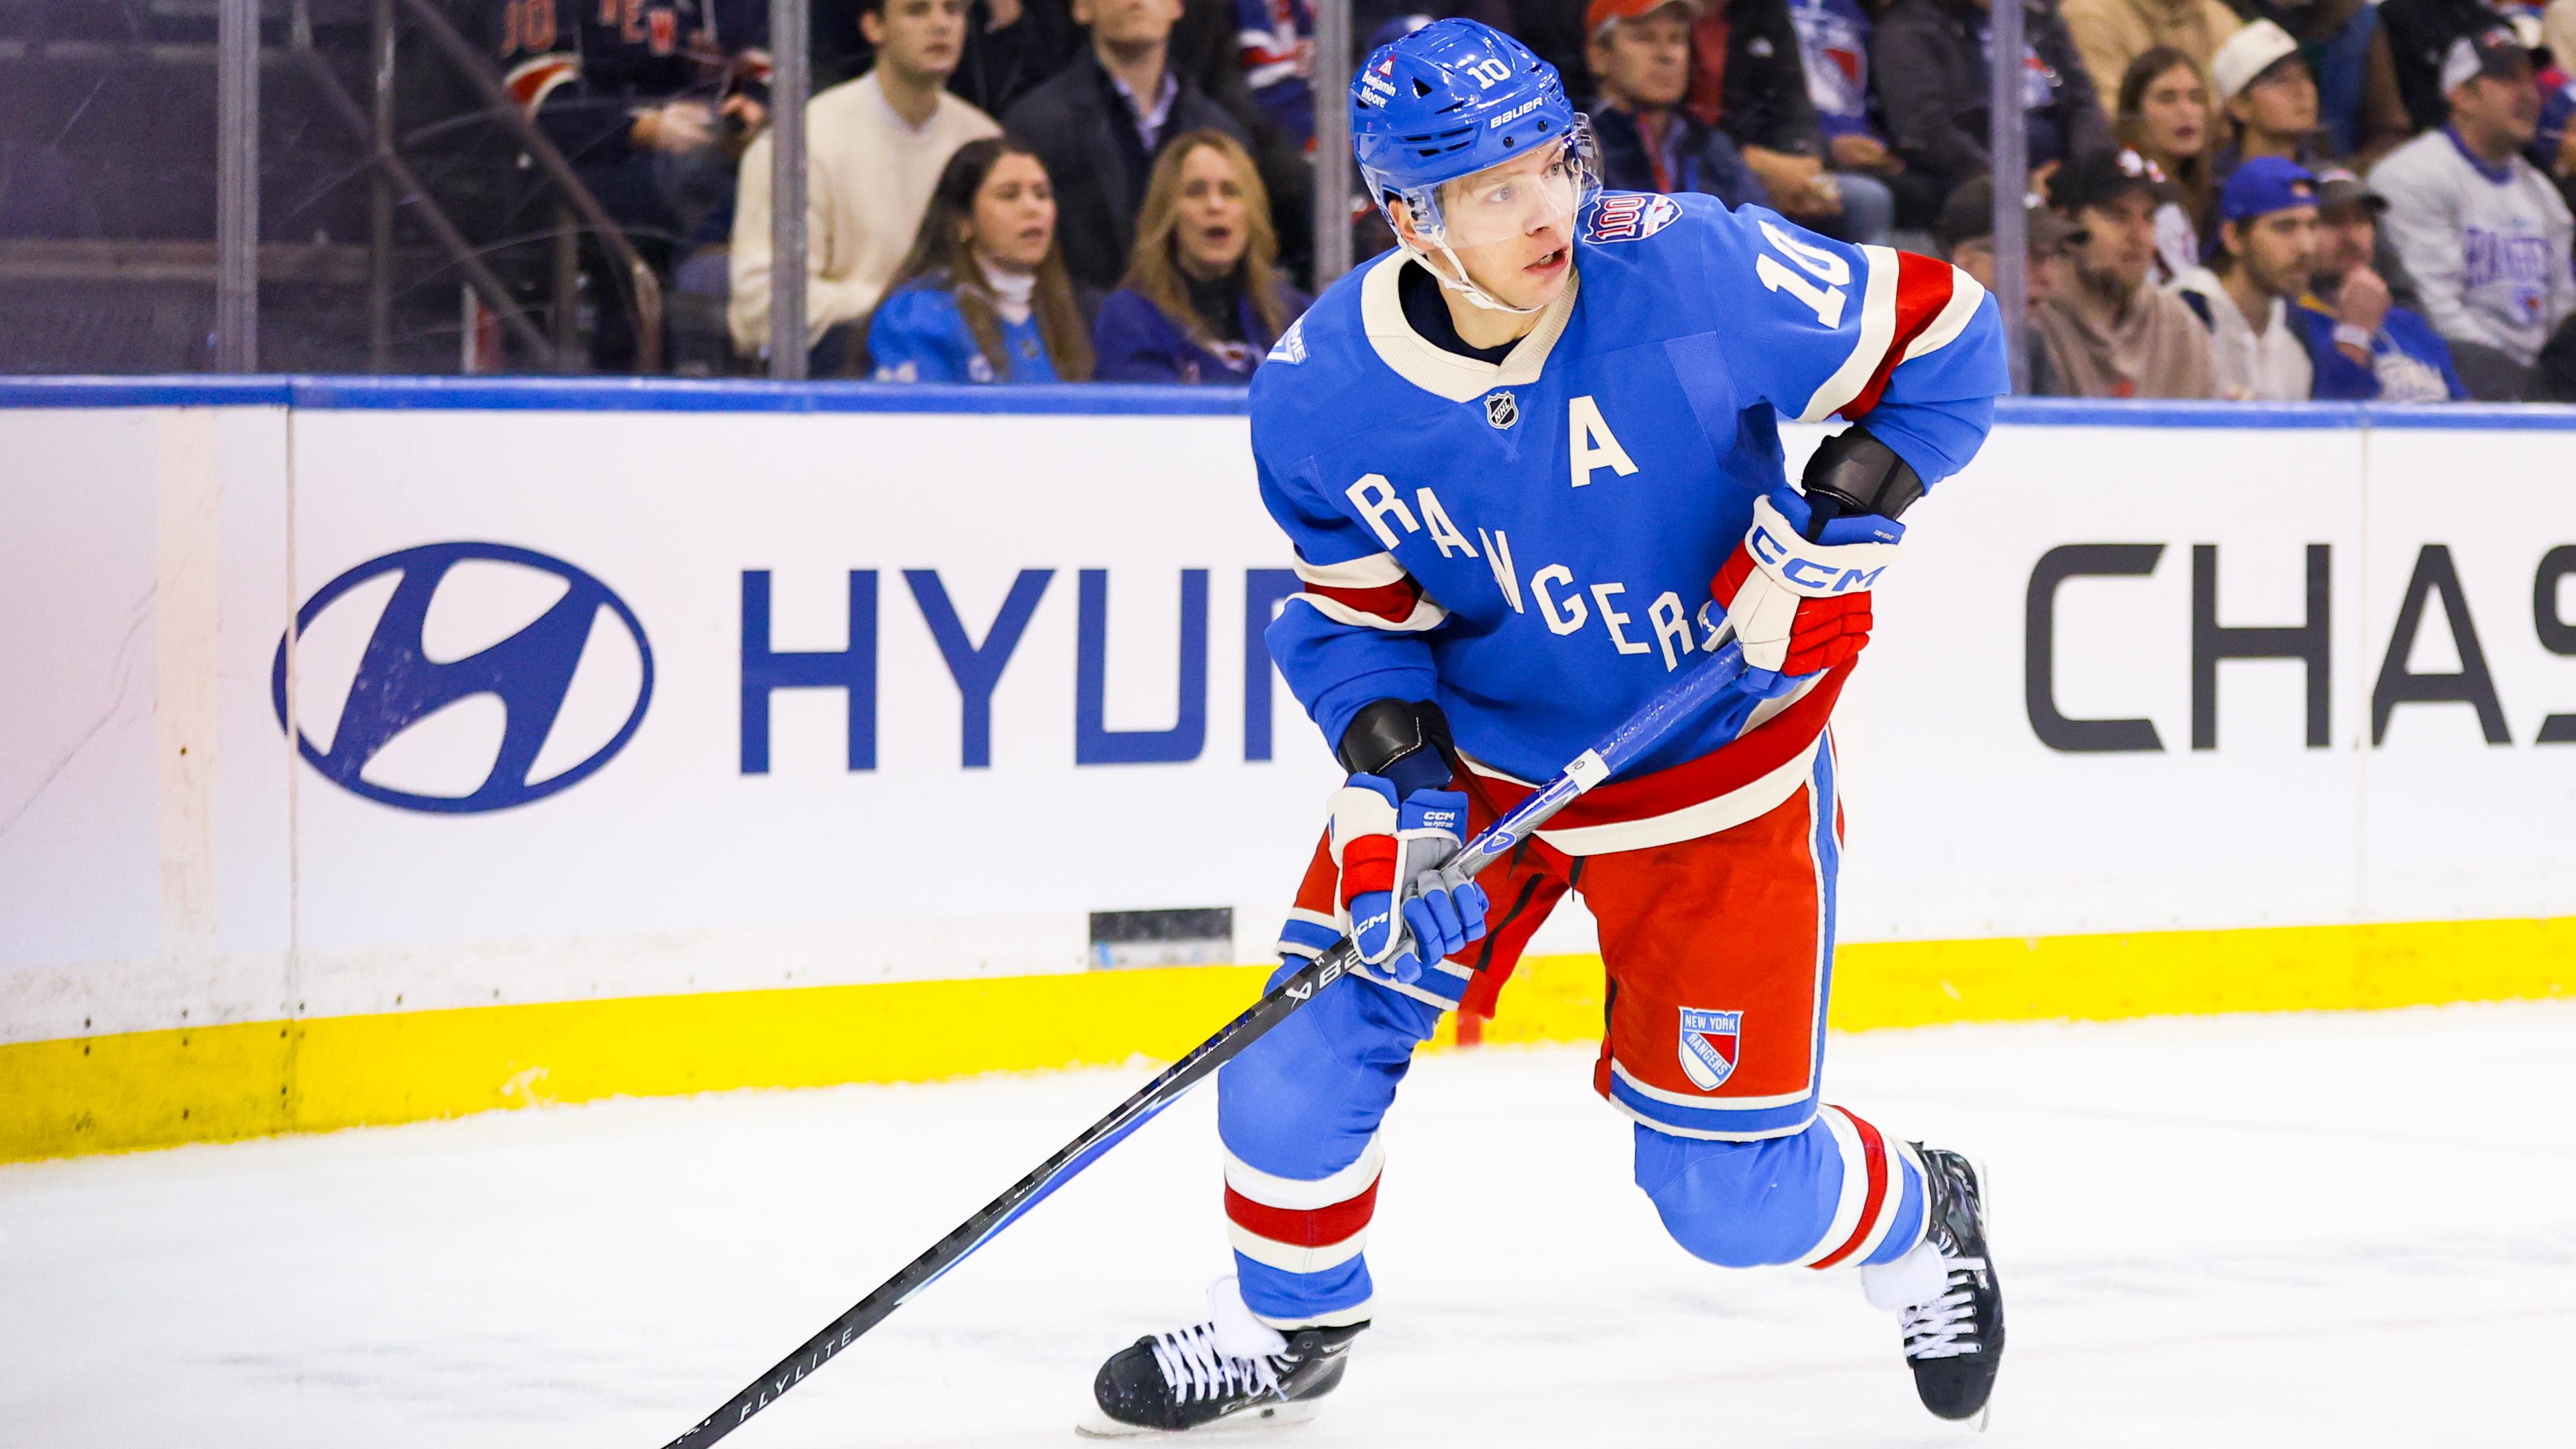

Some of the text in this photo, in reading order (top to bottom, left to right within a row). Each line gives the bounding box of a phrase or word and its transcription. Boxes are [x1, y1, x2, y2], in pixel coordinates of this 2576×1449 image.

[1362, 70, 1397, 97] Benjamin
[1467, 58, 1511, 90] 10
[1361, 86, 1386, 108] Moore
[1596, 197, 1646, 240] 100
[1756, 220, 1851, 329] 10
[1494, 401, 1510, 423] NHL
[1569, 396, 1639, 487] A
[1346, 473, 1714, 672] RANGER
[1752, 526, 1888, 591] CCM
[1423, 812, 1455, 821] CCM
[1356, 912, 1389, 937] CM
[1686, 1015, 1736, 1031] NEW YORK
[1687, 1033, 1728, 1076] RANGERS
[738, 1326, 854, 1424] FLYLITE
